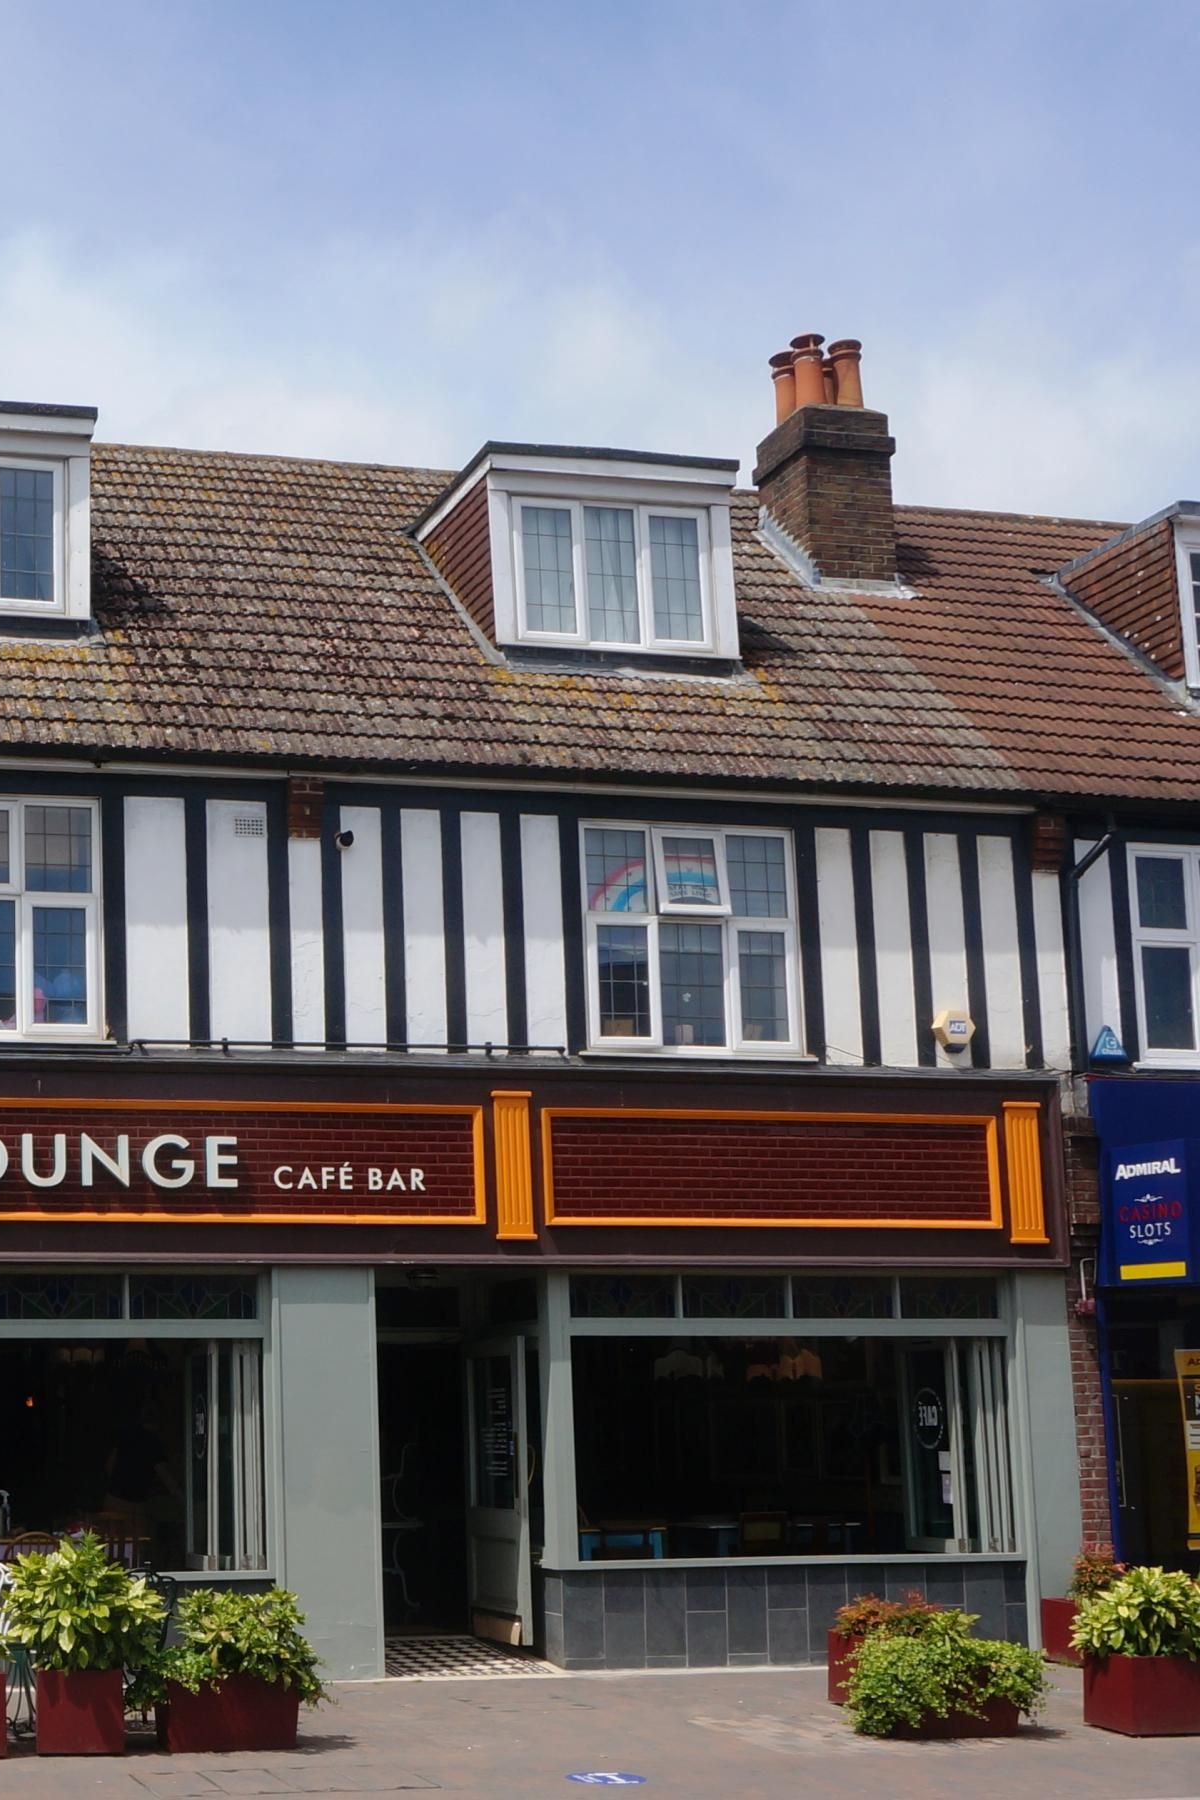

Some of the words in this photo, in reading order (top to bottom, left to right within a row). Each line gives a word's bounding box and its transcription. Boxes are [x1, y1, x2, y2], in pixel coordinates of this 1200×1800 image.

[273, 1161, 354, 1190] CAFÉ
[367, 1167, 426, 1191] BAR
[1115, 1158, 1181, 1180] ADMIRAL
[1119, 1201, 1183, 1223] CASINO
[1129, 1221, 1172, 1239] SLOTS
